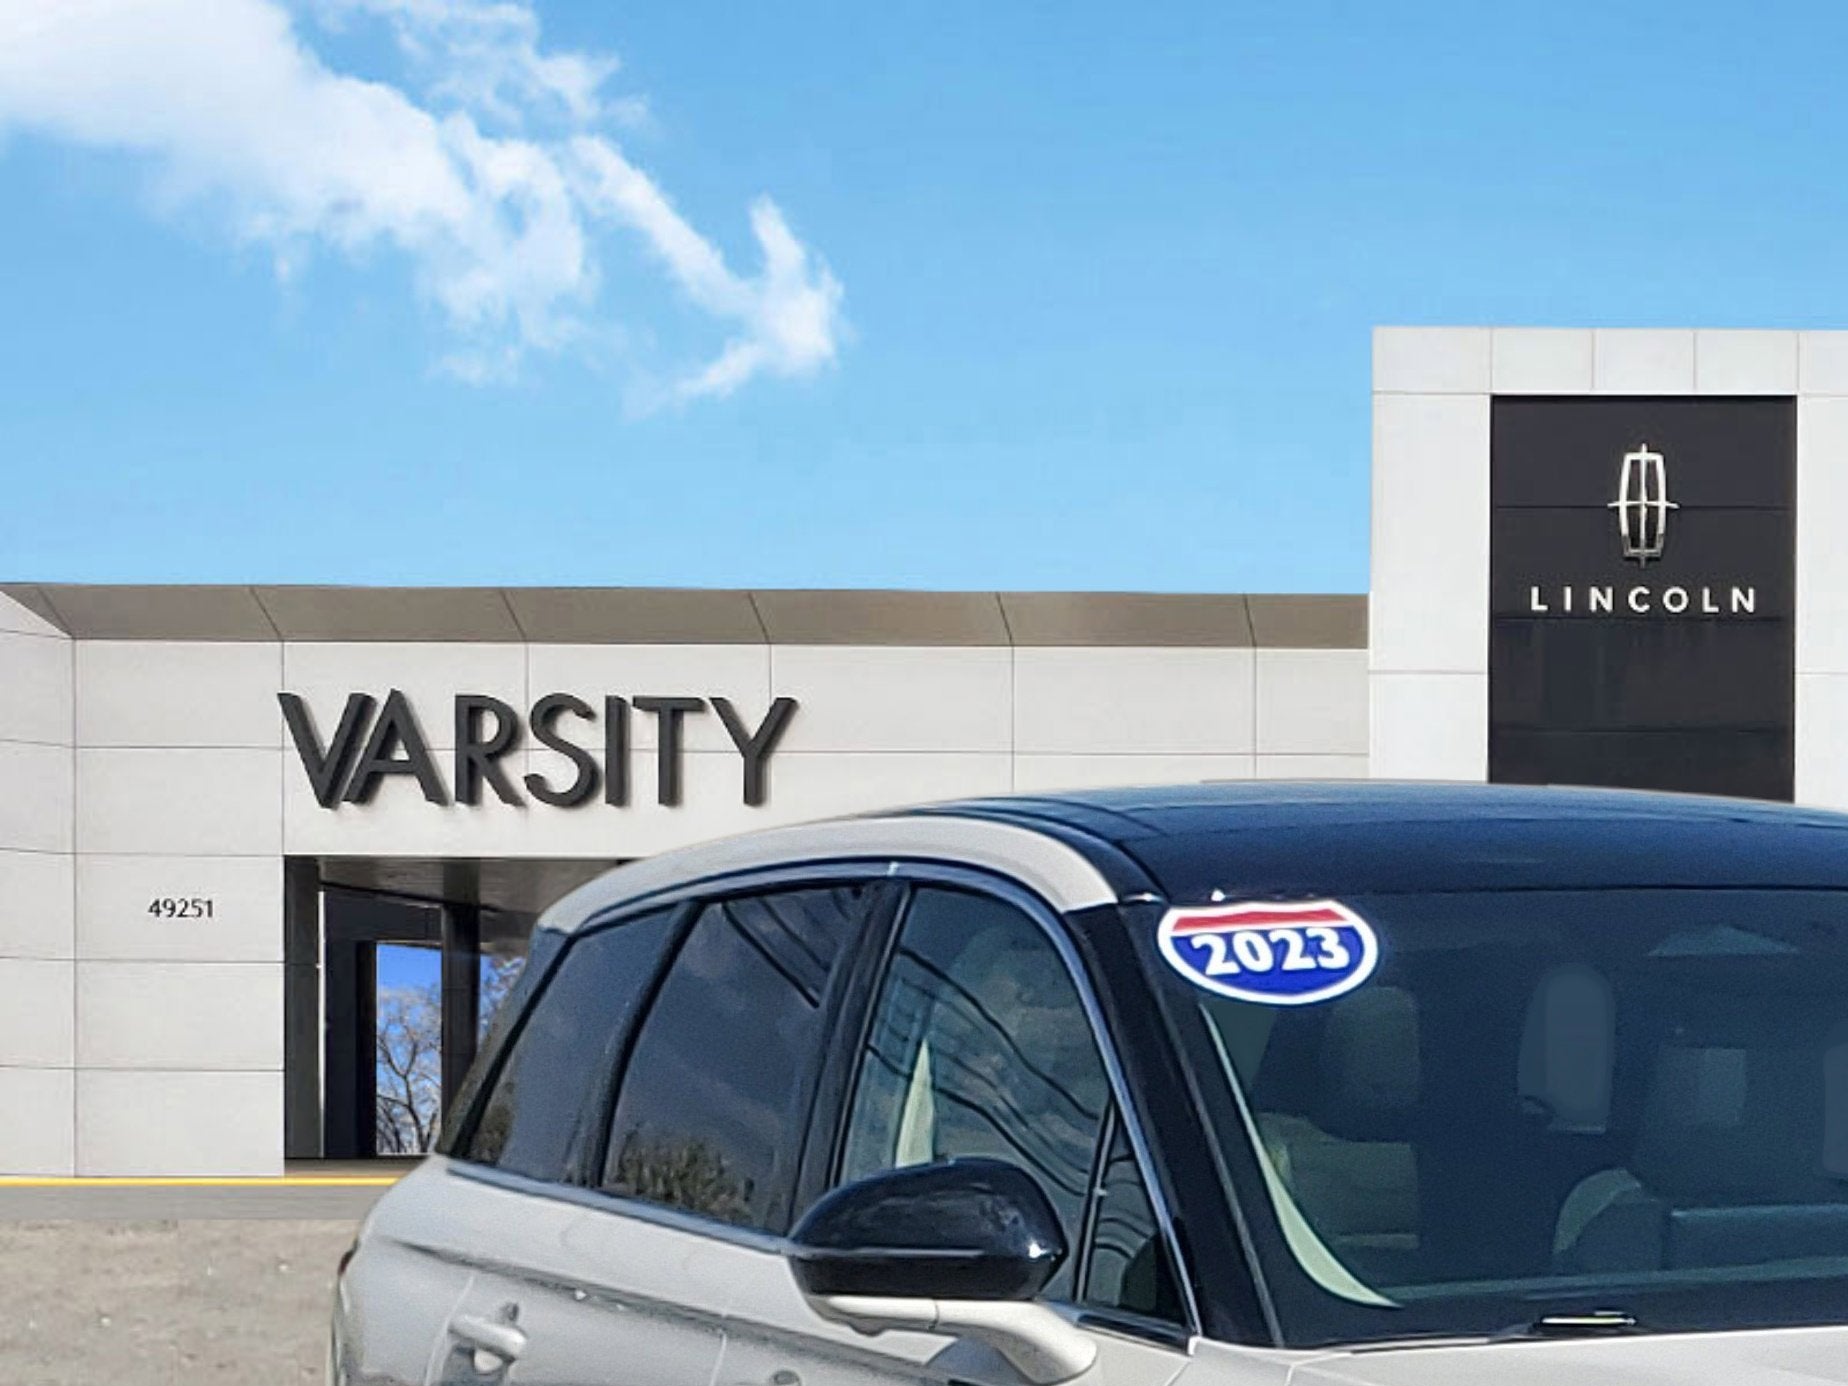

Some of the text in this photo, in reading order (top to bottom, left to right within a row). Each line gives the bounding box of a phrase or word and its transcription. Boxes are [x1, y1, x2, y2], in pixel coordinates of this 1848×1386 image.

[1530, 586, 1756, 613] LINCOLN
[278, 688, 800, 810] VARSITY
[148, 898, 213, 919] 49251
[1193, 927, 1350, 977] 2023
